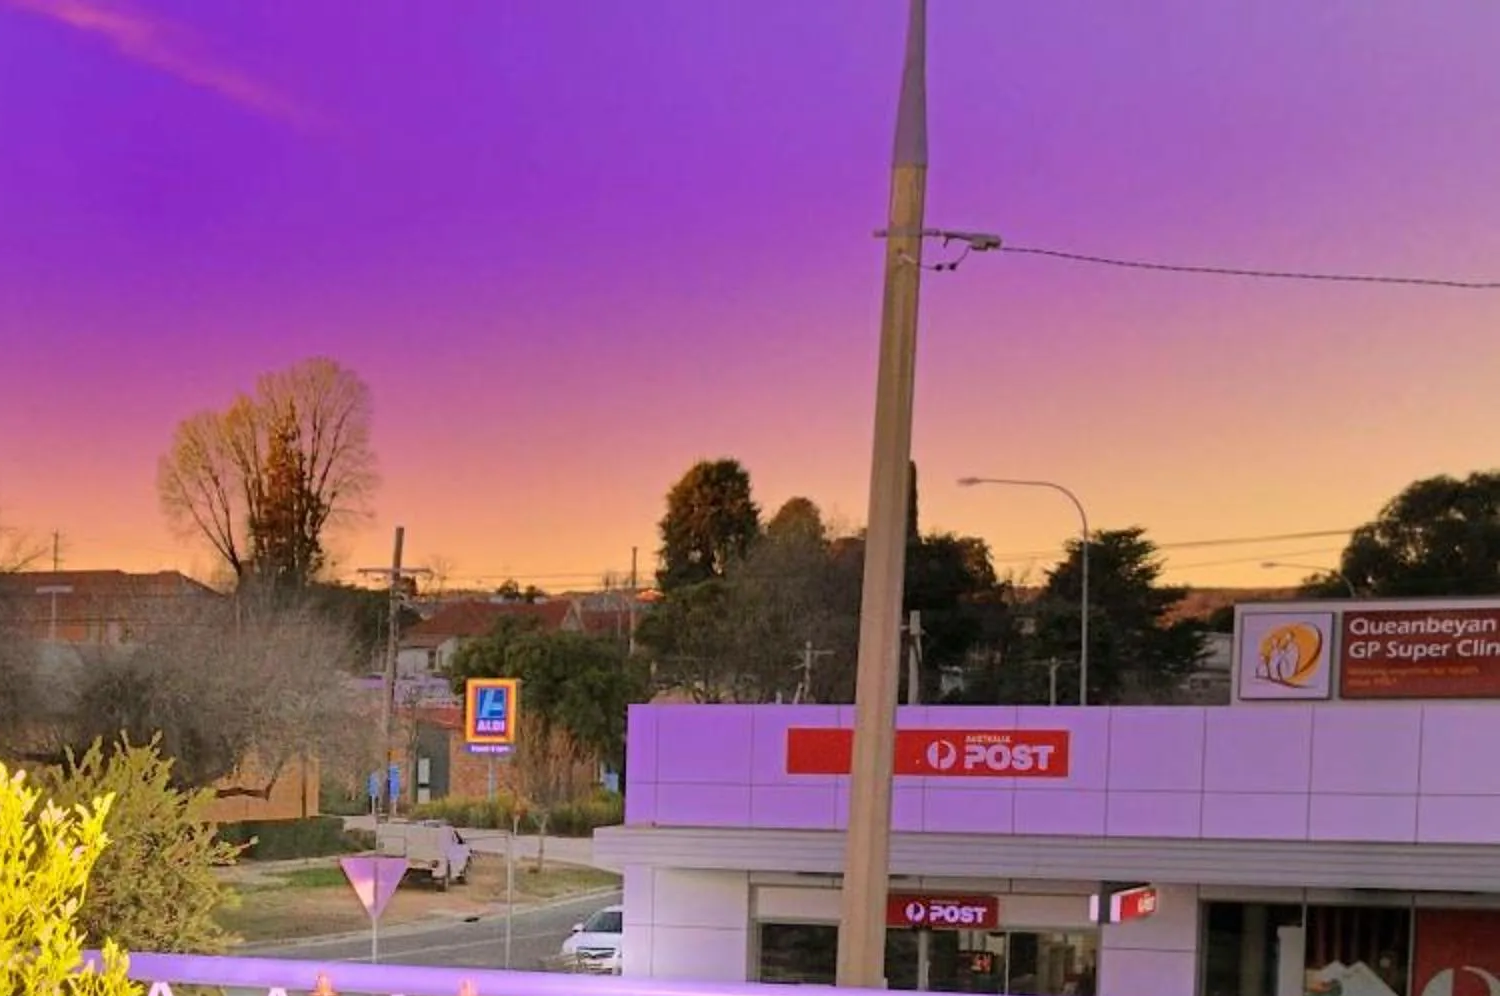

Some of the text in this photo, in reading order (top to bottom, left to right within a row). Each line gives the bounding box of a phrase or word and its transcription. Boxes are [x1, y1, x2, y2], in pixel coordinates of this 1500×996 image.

[1349, 616, 1498, 638] Queanbeyan
[1348, 641, 1381, 659] GP
[1385, 640, 1451, 663] Super
[476, 719, 506, 732] ALDI
[963, 744, 1056, 771] POST
[928, 904, 988, 924] POST
